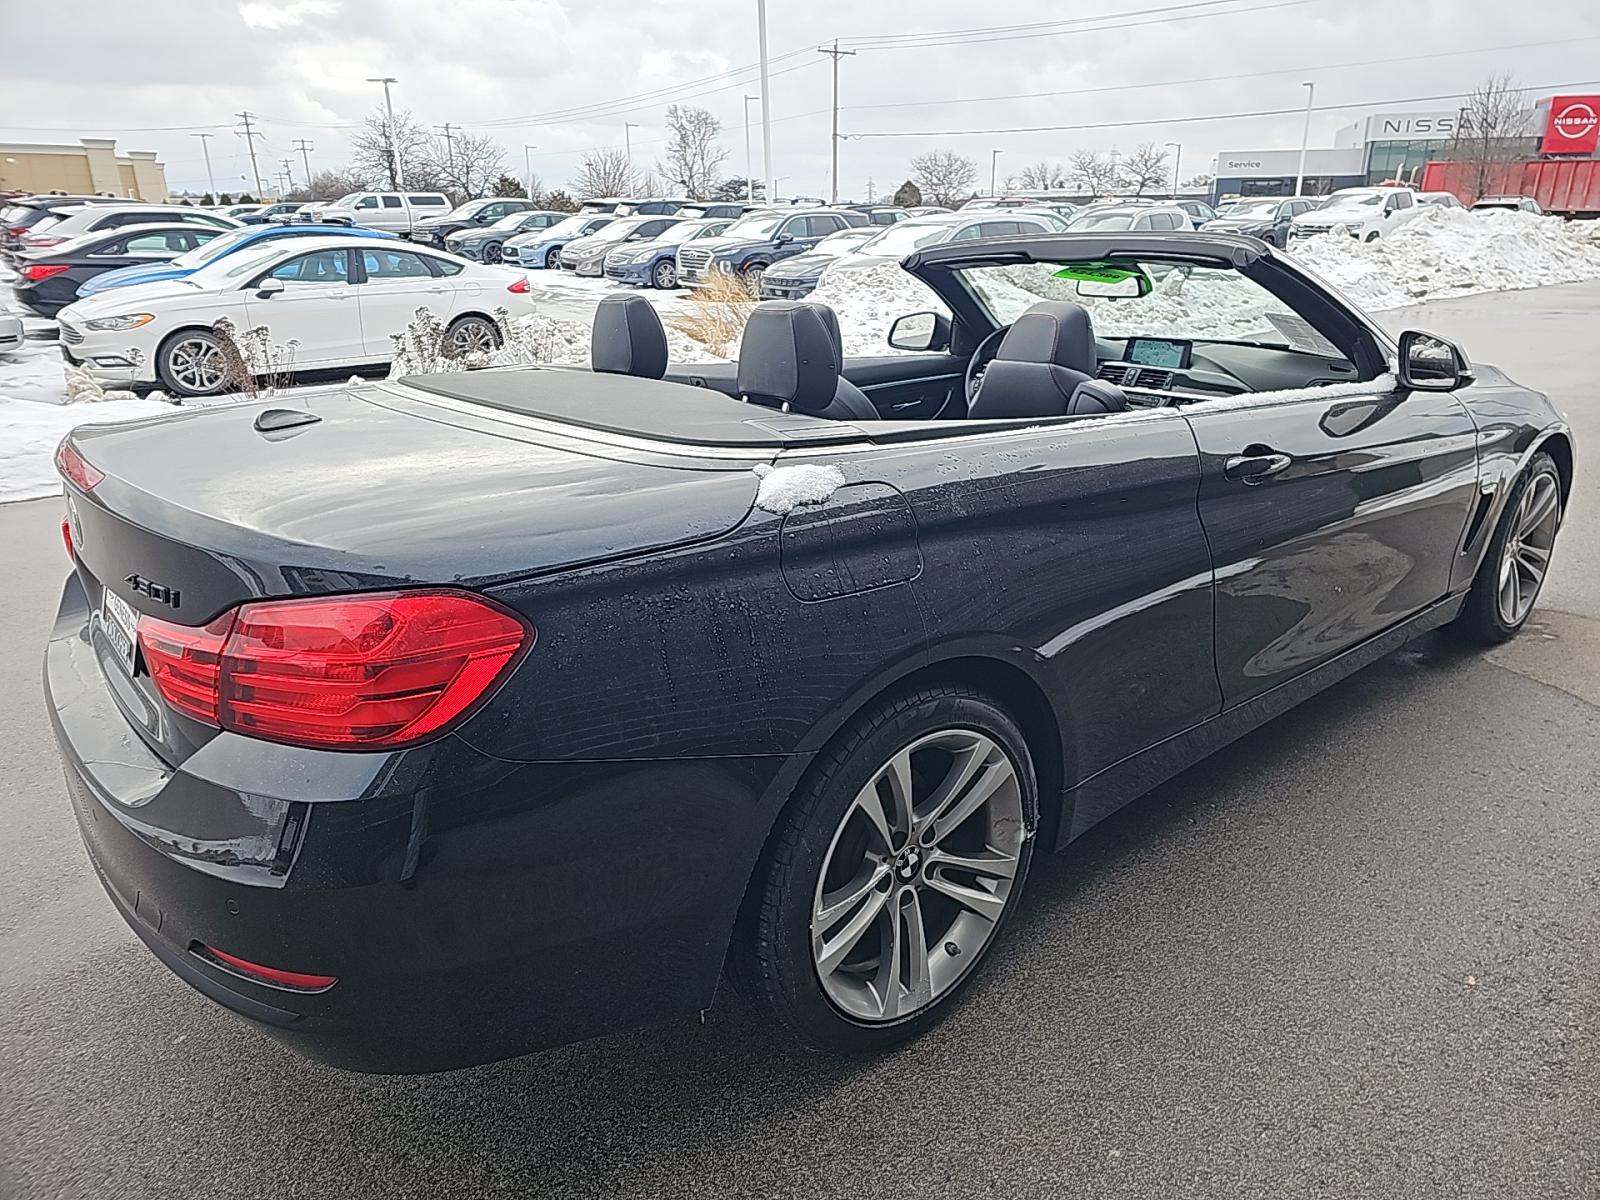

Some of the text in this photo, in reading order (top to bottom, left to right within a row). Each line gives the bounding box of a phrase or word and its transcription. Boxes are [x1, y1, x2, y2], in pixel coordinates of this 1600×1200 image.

[1384, 117, 1497, 134] NISSAN
[1554, 117, 1599, 125] NISSAN
[1228, 160, 1261, 169] Service
